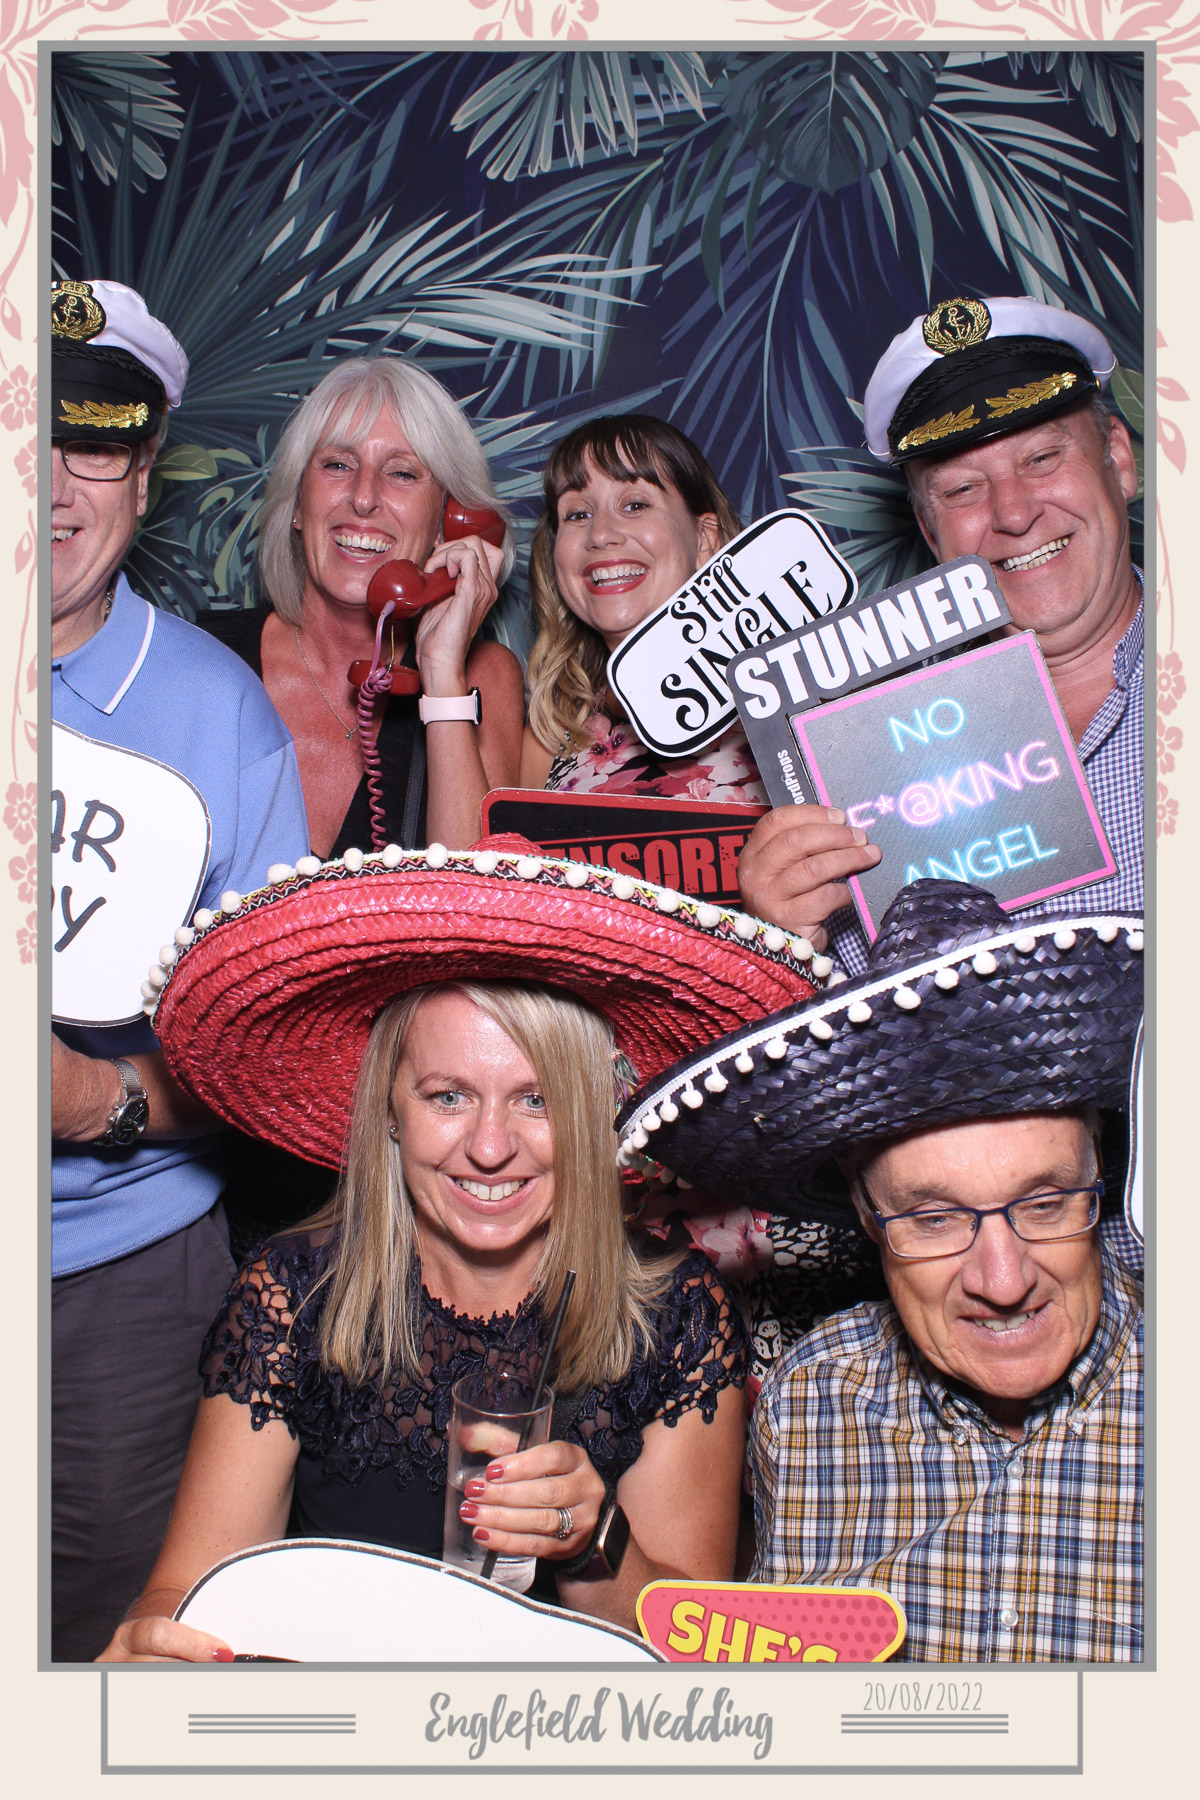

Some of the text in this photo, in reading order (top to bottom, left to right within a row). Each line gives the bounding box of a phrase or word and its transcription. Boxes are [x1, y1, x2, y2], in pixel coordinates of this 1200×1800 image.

[670, 553, 752, 644] Still
[733, 562, 1002, 720] STUNNER
[660, 560, 833, 732] SINGLE
[887, 697, 965, 753] NO
[777, 749, 806, 805] ordProps
